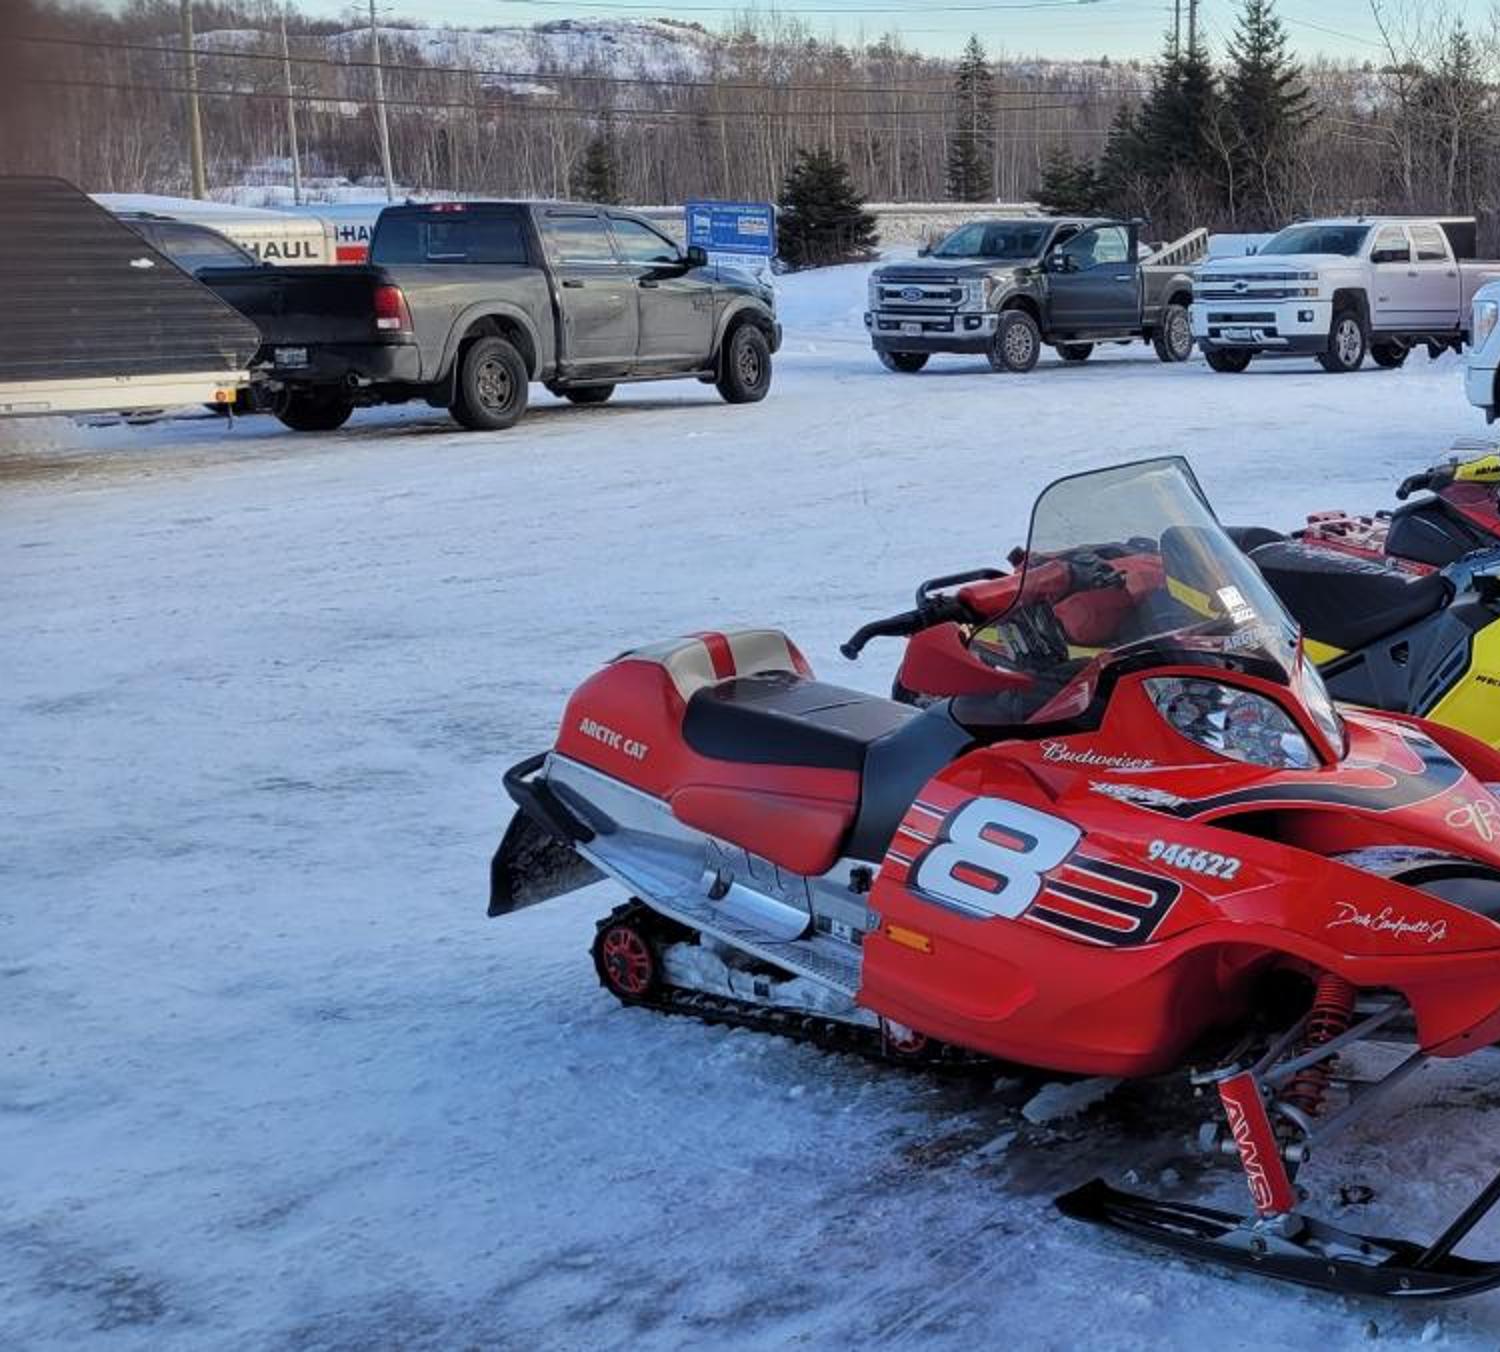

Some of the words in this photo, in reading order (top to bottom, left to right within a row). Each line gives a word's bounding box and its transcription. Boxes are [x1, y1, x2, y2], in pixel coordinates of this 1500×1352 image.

[579, 717, 623, 750] ARCTIC
[622, 739, 649, 760] CAT
[1039, 739, 1155, 769] Budweiser
[908, 795, 1086, 921] 8
[1147, 839, 1241, 880] 946622
[1220, 1095, 1273, 1209] AWS
